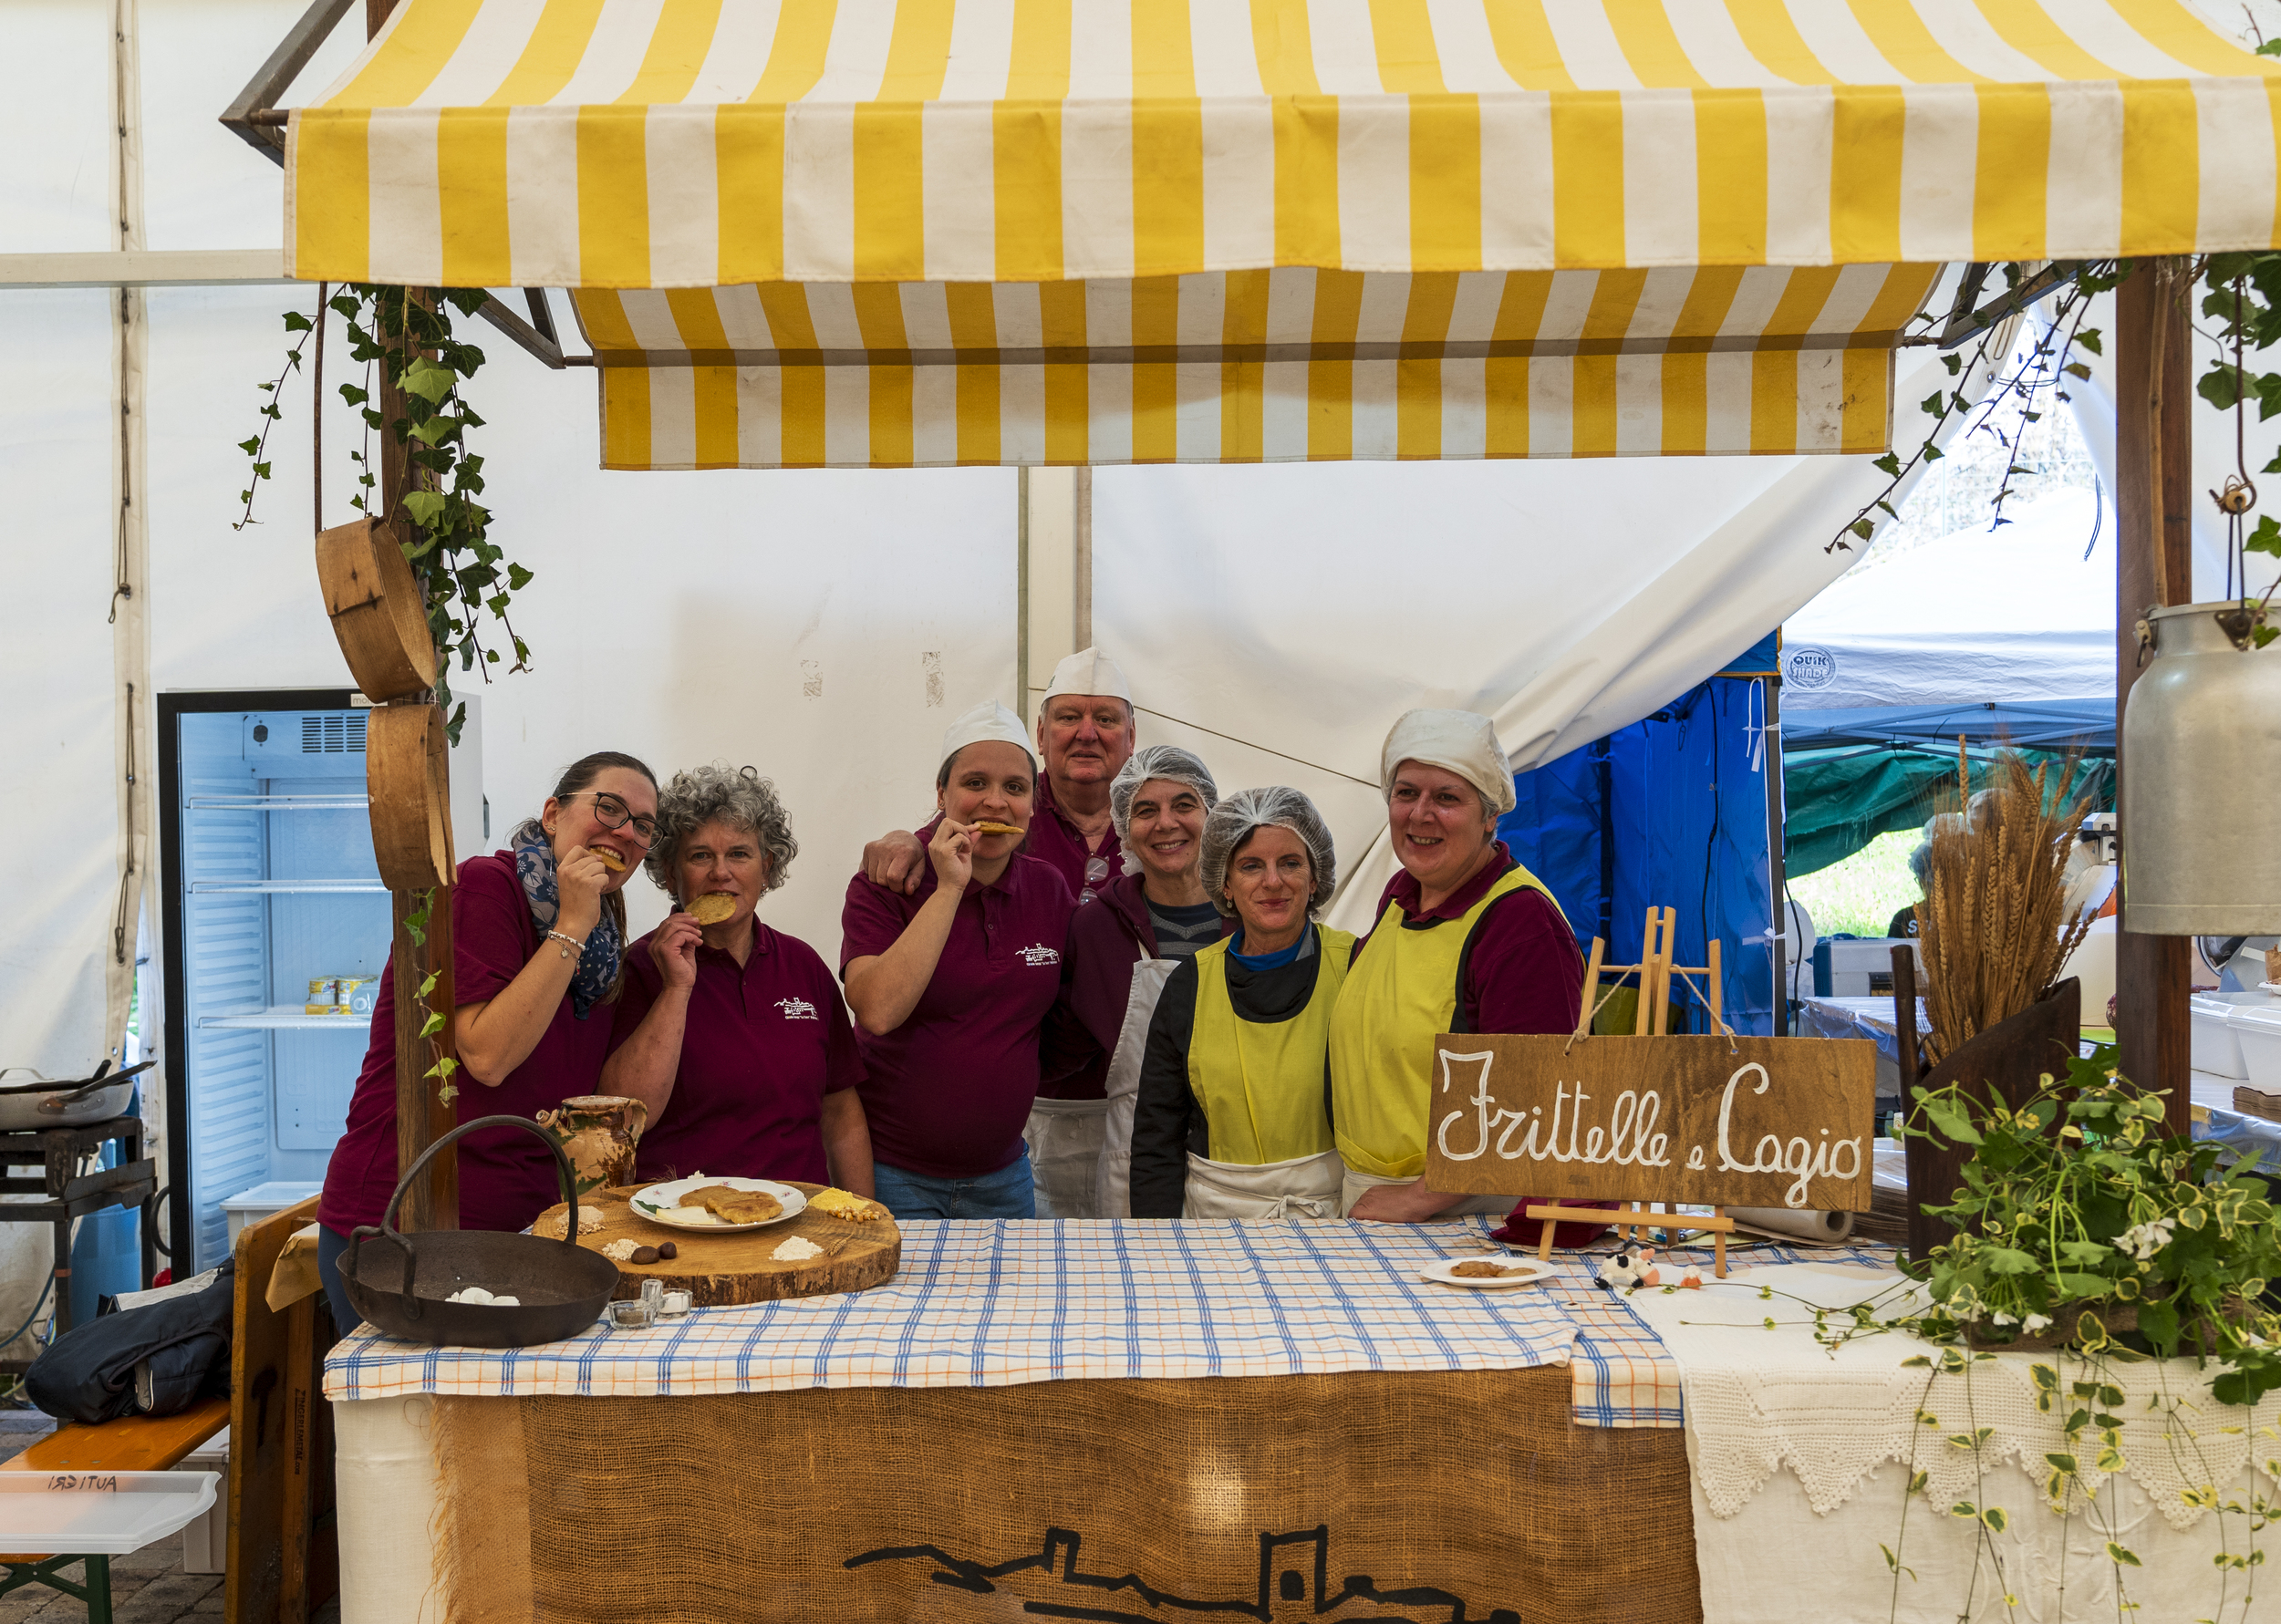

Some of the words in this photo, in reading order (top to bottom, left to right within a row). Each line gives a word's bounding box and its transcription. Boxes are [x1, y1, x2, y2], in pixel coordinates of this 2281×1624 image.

[1792, 667, 1829, 678] SHADE
[1436, 1048, 1671, 1167] Frittelle
[1685, 1143, 1706, 1171] e
[1716, 1062, 1862, 1208] Cagio
